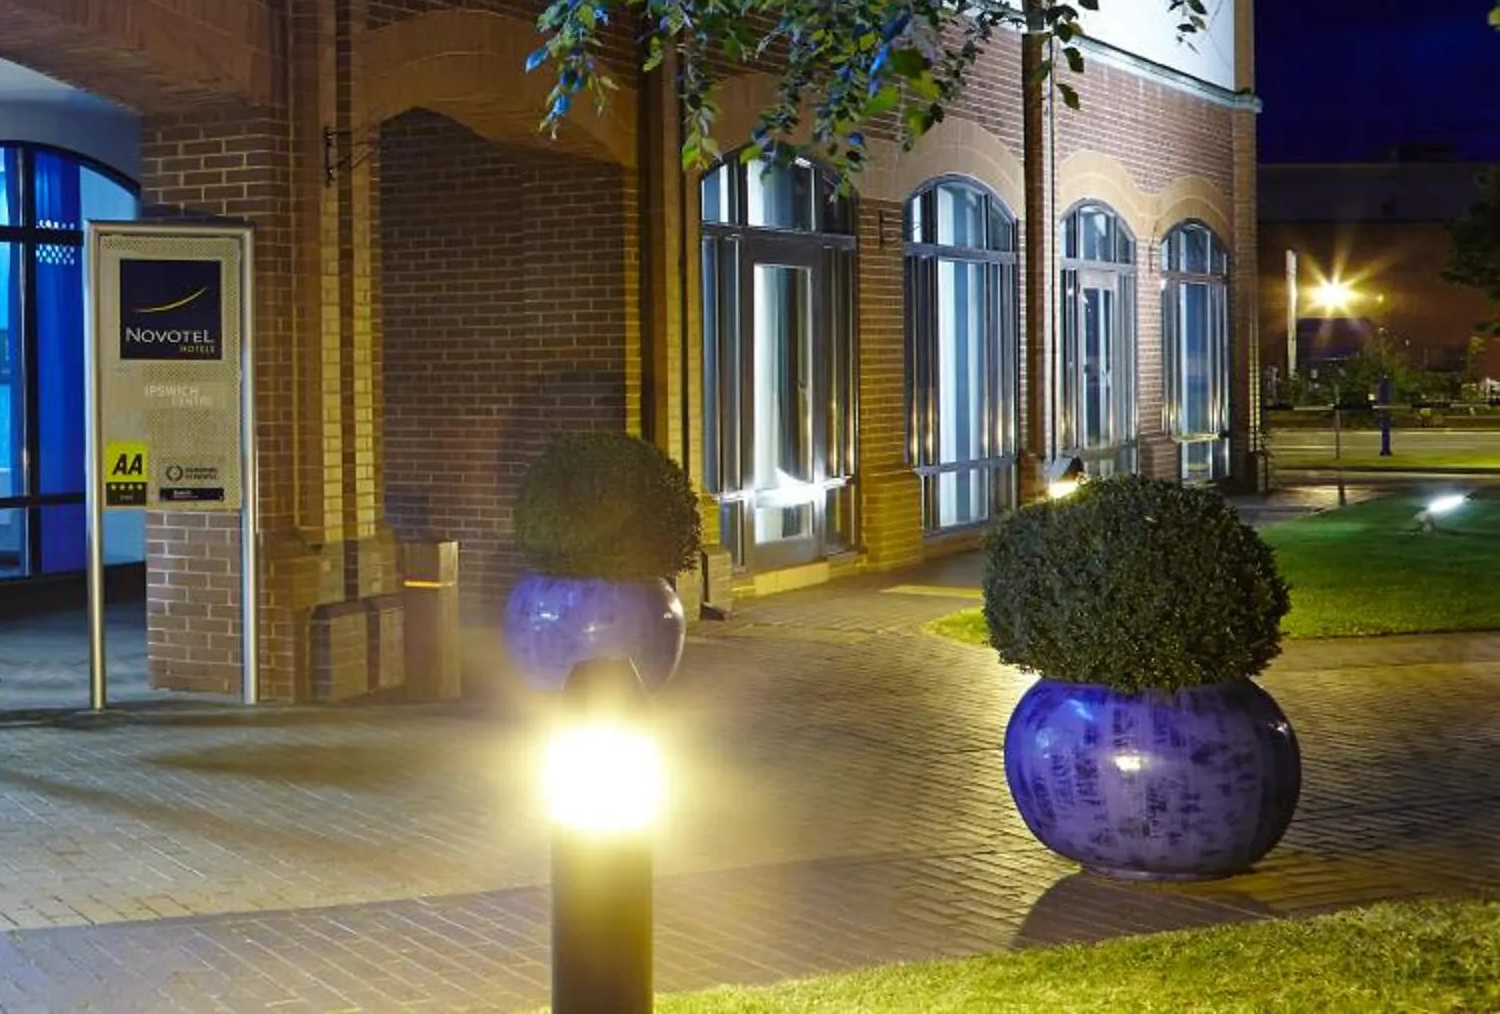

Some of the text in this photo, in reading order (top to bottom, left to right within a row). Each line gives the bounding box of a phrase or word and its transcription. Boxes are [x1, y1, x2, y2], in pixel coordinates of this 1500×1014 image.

[125, 327, 215, 344] NOVOTEL
[144, 385, 200, 397] IPSWICH
[112, 453, 143, 476] AA
